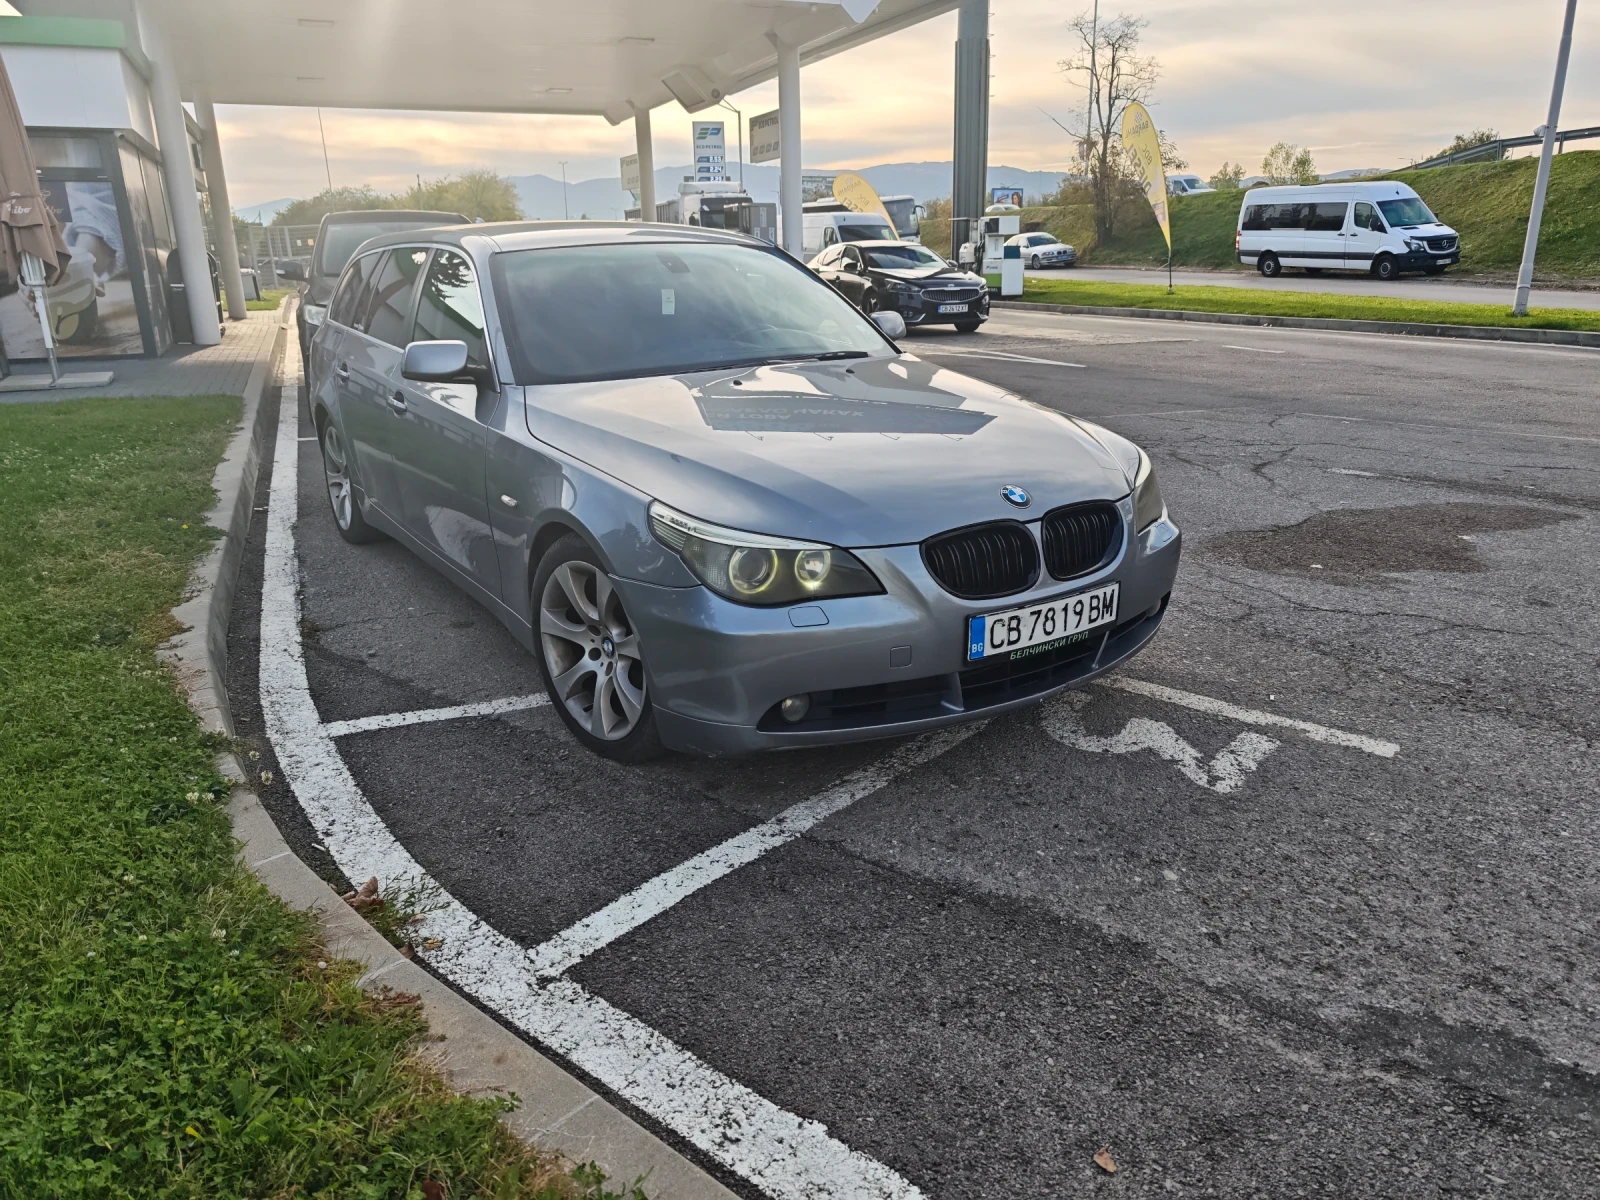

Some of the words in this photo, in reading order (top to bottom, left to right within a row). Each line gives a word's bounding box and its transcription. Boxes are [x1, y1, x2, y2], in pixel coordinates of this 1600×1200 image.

[989, 614, 1022, 649] CB
[1028, 599, 1084, 642] 7819
[1088, 589, 1115, 625] BM
[971, 642, 984, 653] BG
[1010, 637, 1066, 660] БЕЛЧИНСКИ
[1067, 631, 1089, 644] ГРУП
